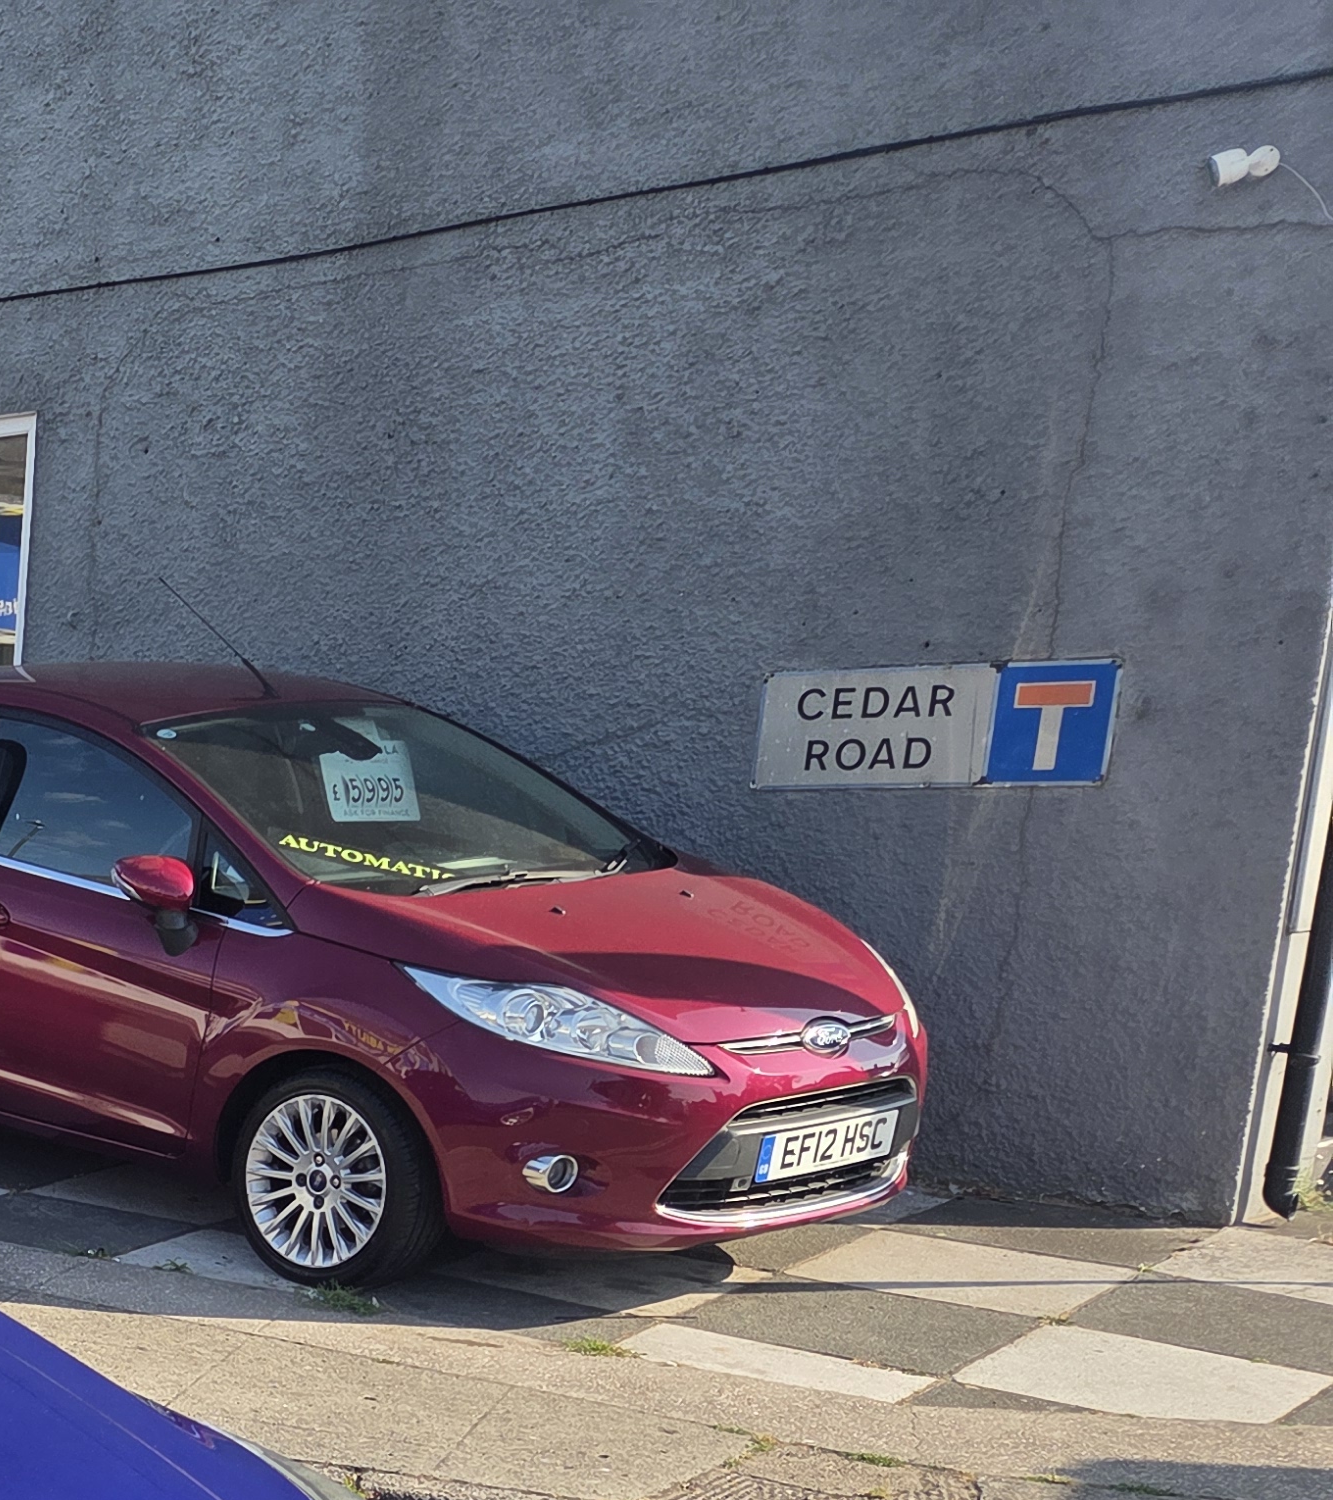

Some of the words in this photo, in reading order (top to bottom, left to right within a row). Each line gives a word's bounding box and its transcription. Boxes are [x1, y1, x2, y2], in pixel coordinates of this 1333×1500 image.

[796, 684, 956, 722] CEDAR
[803, 737, 933, 772] ROAD
[349, 776, 405, 803] 5995
[780, 1128, 839, 1170] EF12
[840, 1117, 888, 1158] HSC
